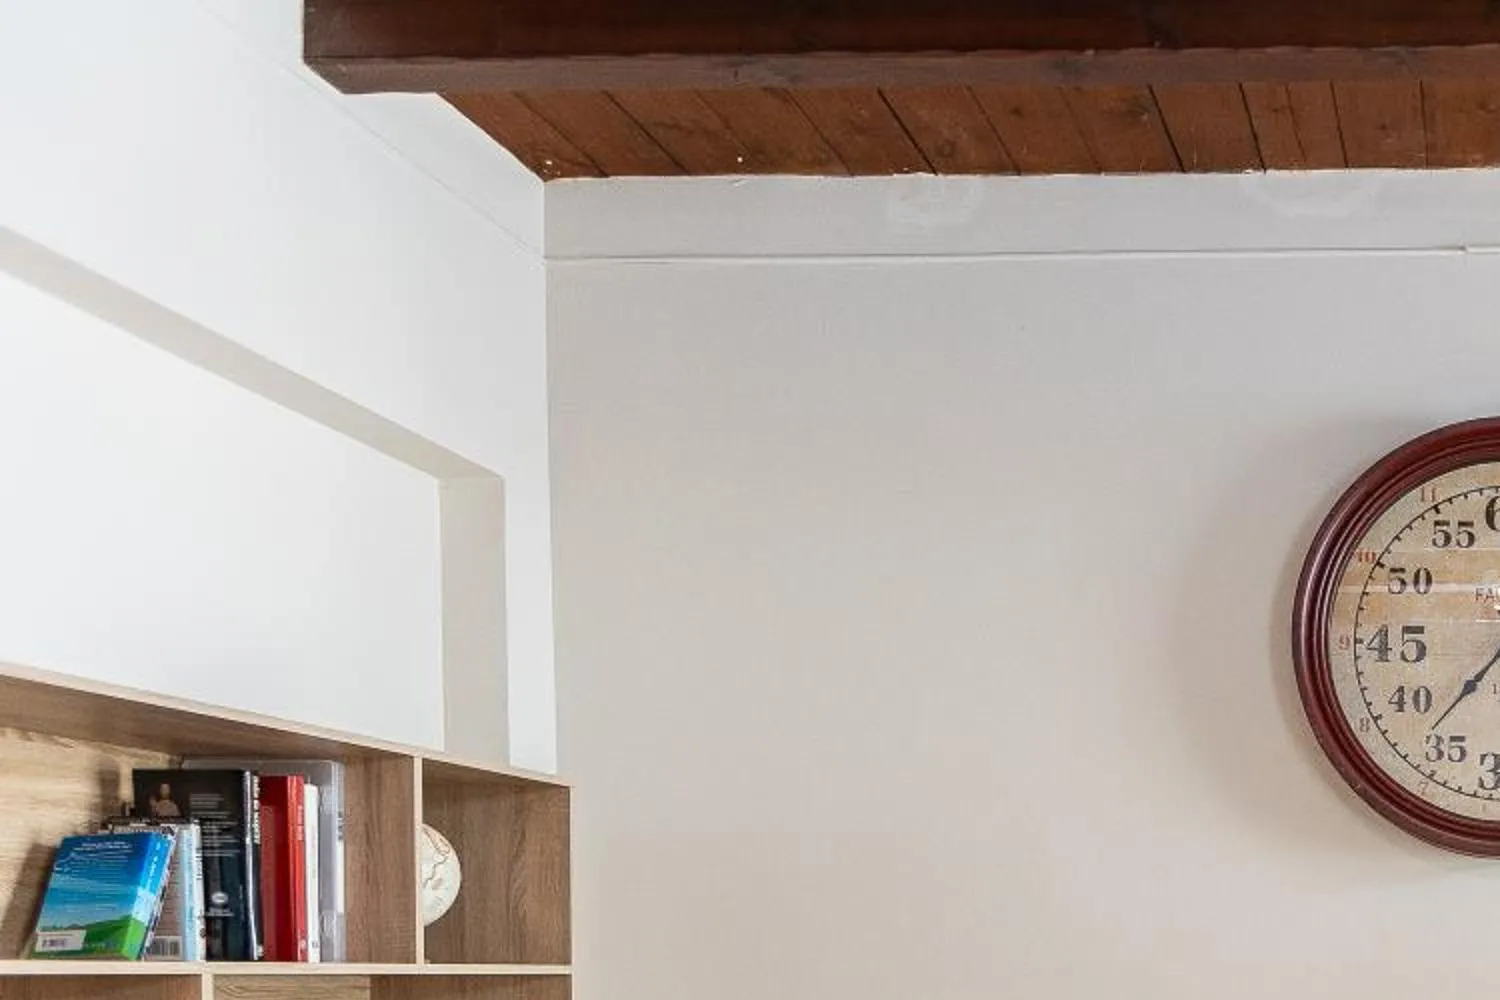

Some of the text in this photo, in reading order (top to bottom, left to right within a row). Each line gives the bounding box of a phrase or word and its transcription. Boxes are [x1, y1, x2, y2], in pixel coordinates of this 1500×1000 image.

[1432, 520, 1476, 549] 55
[1388, 567, 1433, 595] 50
[1366, 624, 1427, 663] 45
[1388, 685, 1433, 713] 40
[1424, 733, 1467, 763] 35
